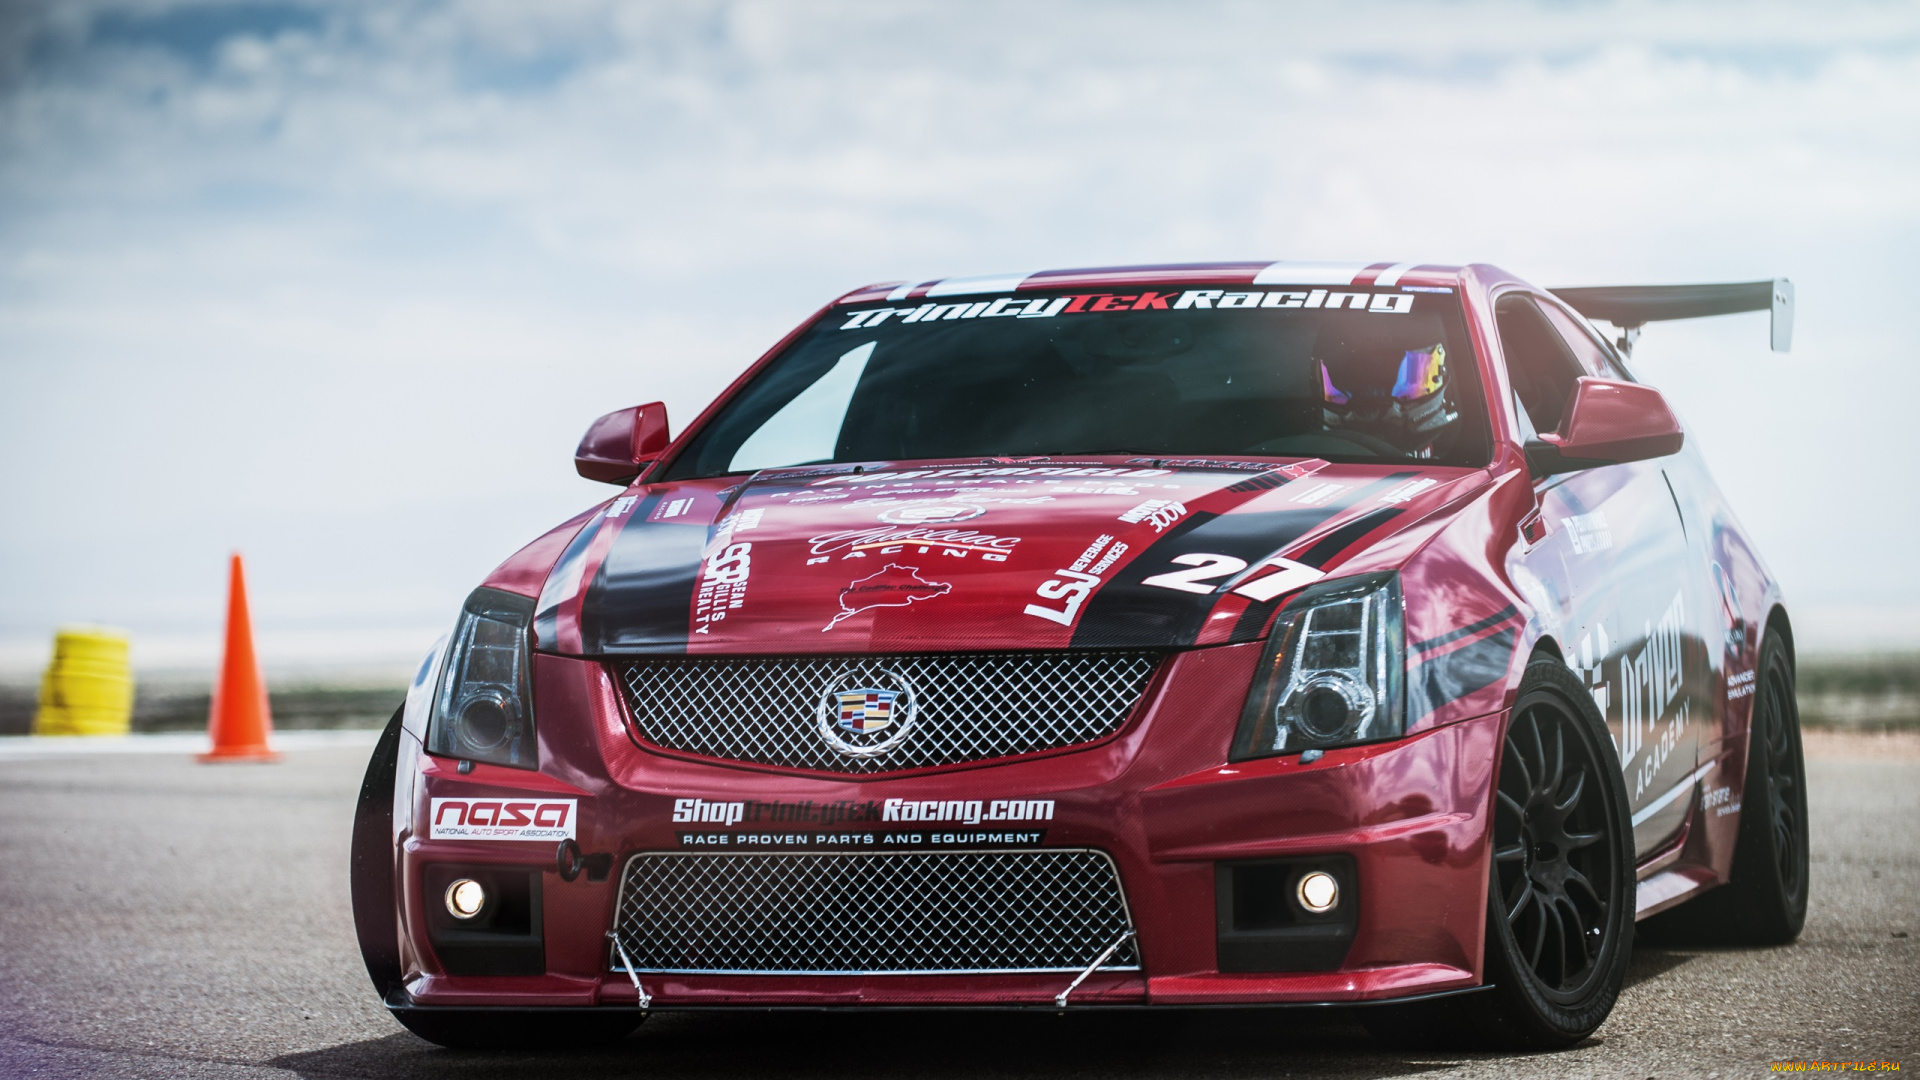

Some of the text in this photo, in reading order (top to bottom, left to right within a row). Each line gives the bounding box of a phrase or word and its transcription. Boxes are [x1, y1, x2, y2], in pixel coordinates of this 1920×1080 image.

[806, 545, 1009, 566] RACING
[807, 525, 1022, 555] Cadillac
[1068, 533, 1114, 572] BEVERAGE
[1087, 540, 1129, 575] SERVICES
[728, 580, 748, 609] SEAN
[859, 584, 897, 593] Cadillac
[899, 583, 949, 594] Challenge
[1139, 552, 1327, 604] 27
[695, 585, 714, 635] REALTY
[711, 583, 731, 622] GILLIS
[1023, 568, 1101, 627] LSJ
[1635, 695, 1690, 801] ACADEMY
[434, 828, 570, 838] NATIONAL AUTO SPORT ASSOCIATION
[683, 833, 1041, 845] RACE PROVEN PARTS AND EQUIPMENT
